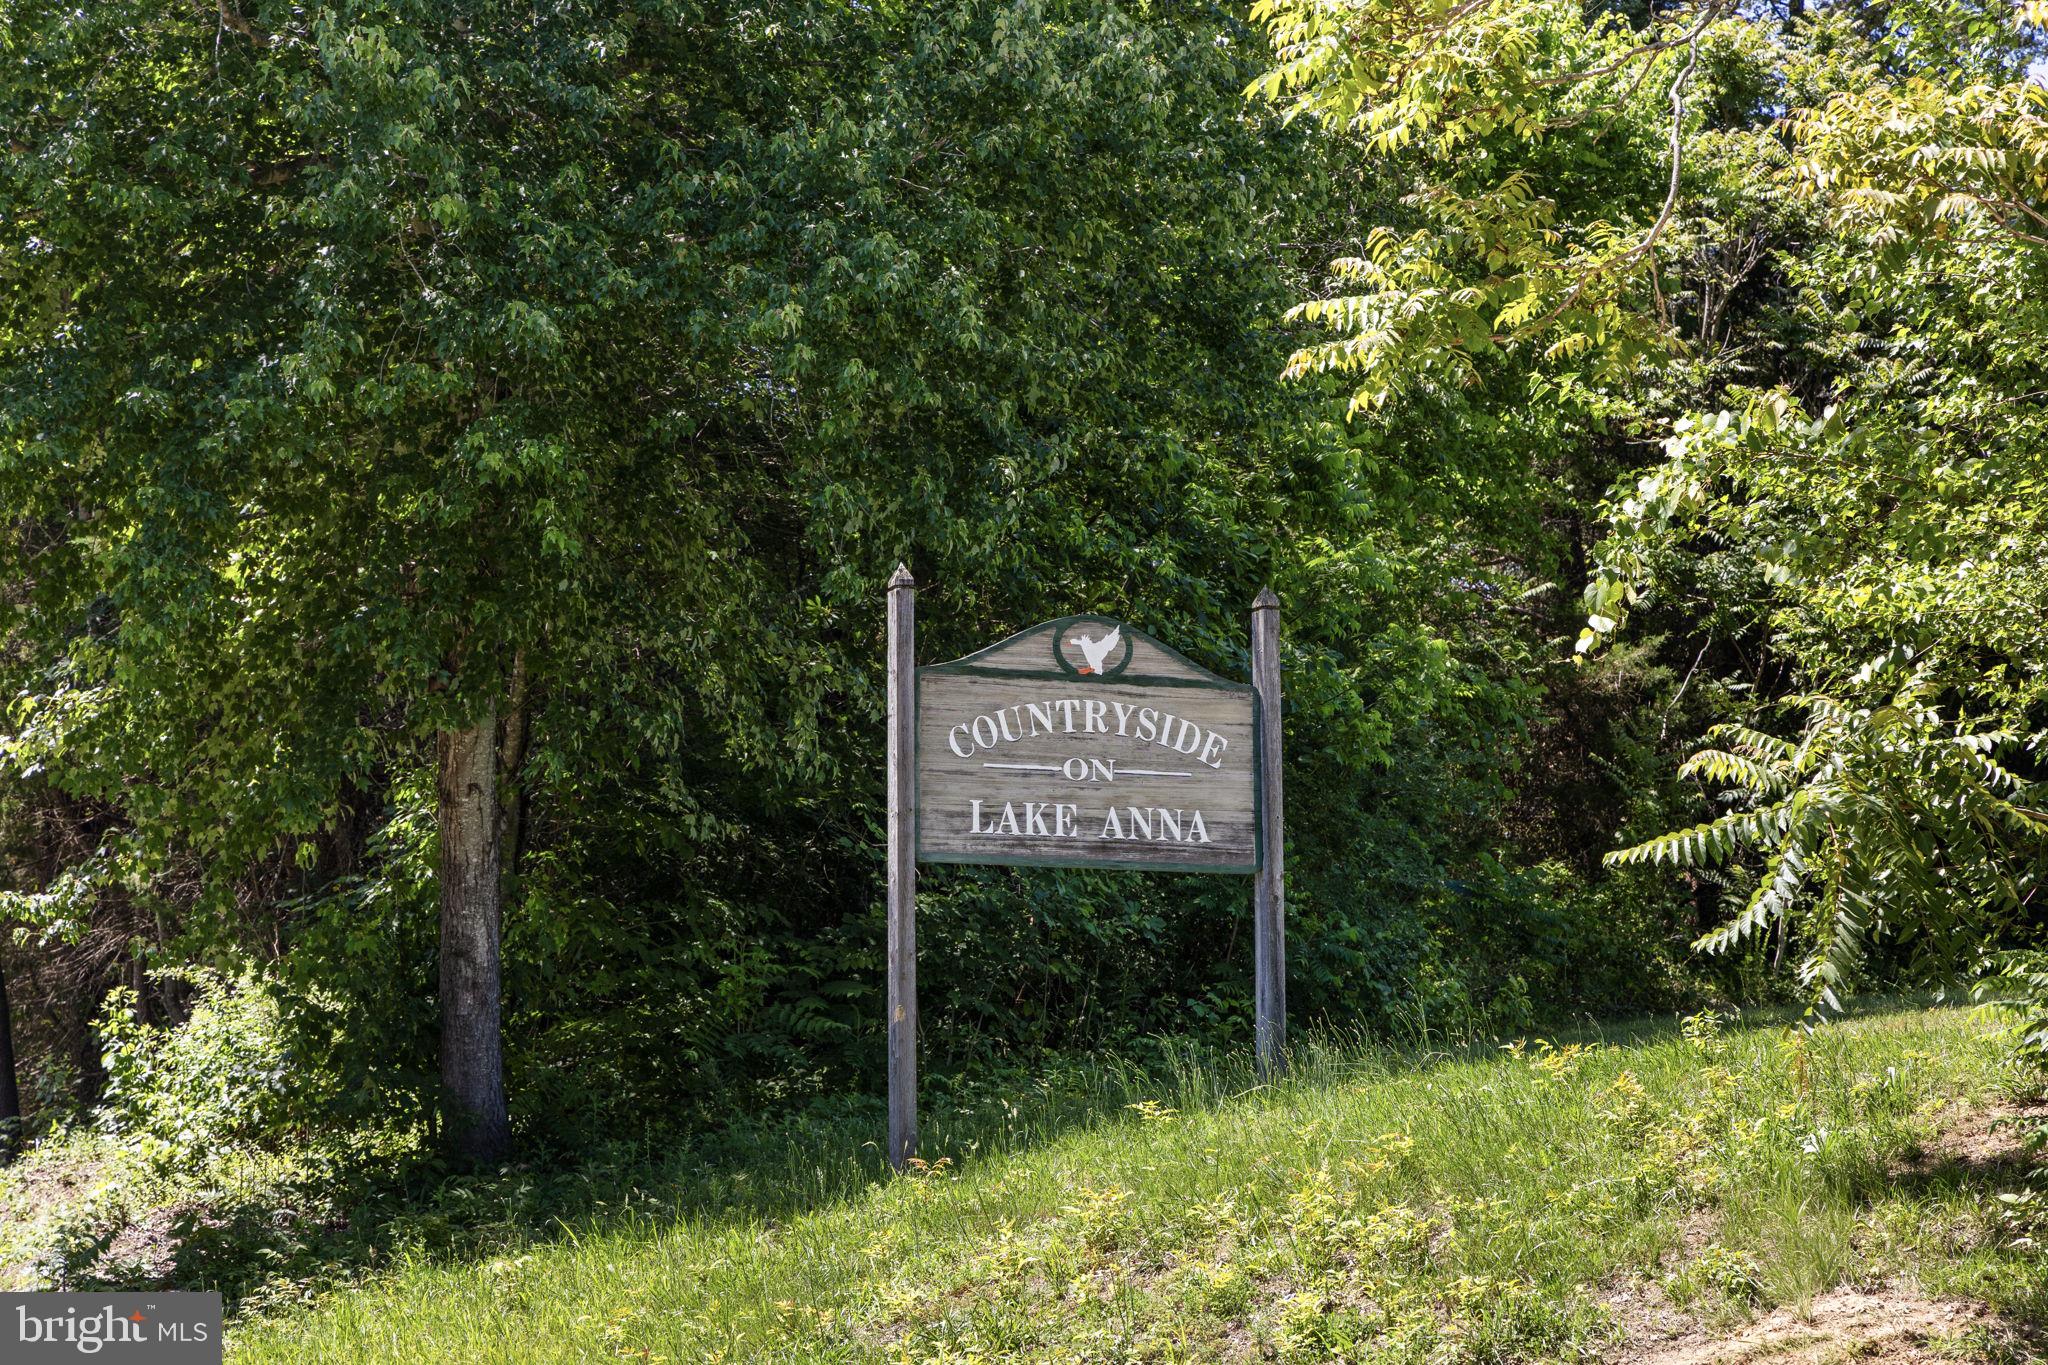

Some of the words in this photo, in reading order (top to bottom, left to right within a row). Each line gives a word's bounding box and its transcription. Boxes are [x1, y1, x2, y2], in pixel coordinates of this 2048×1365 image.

[949, 700, 1229, 769] COUNTRYSIDE
[1063, 757, 1116, 782] ON
[969, 799, 1078, 838] LAKE
[1098, 806, 1212, 844] ANNA
